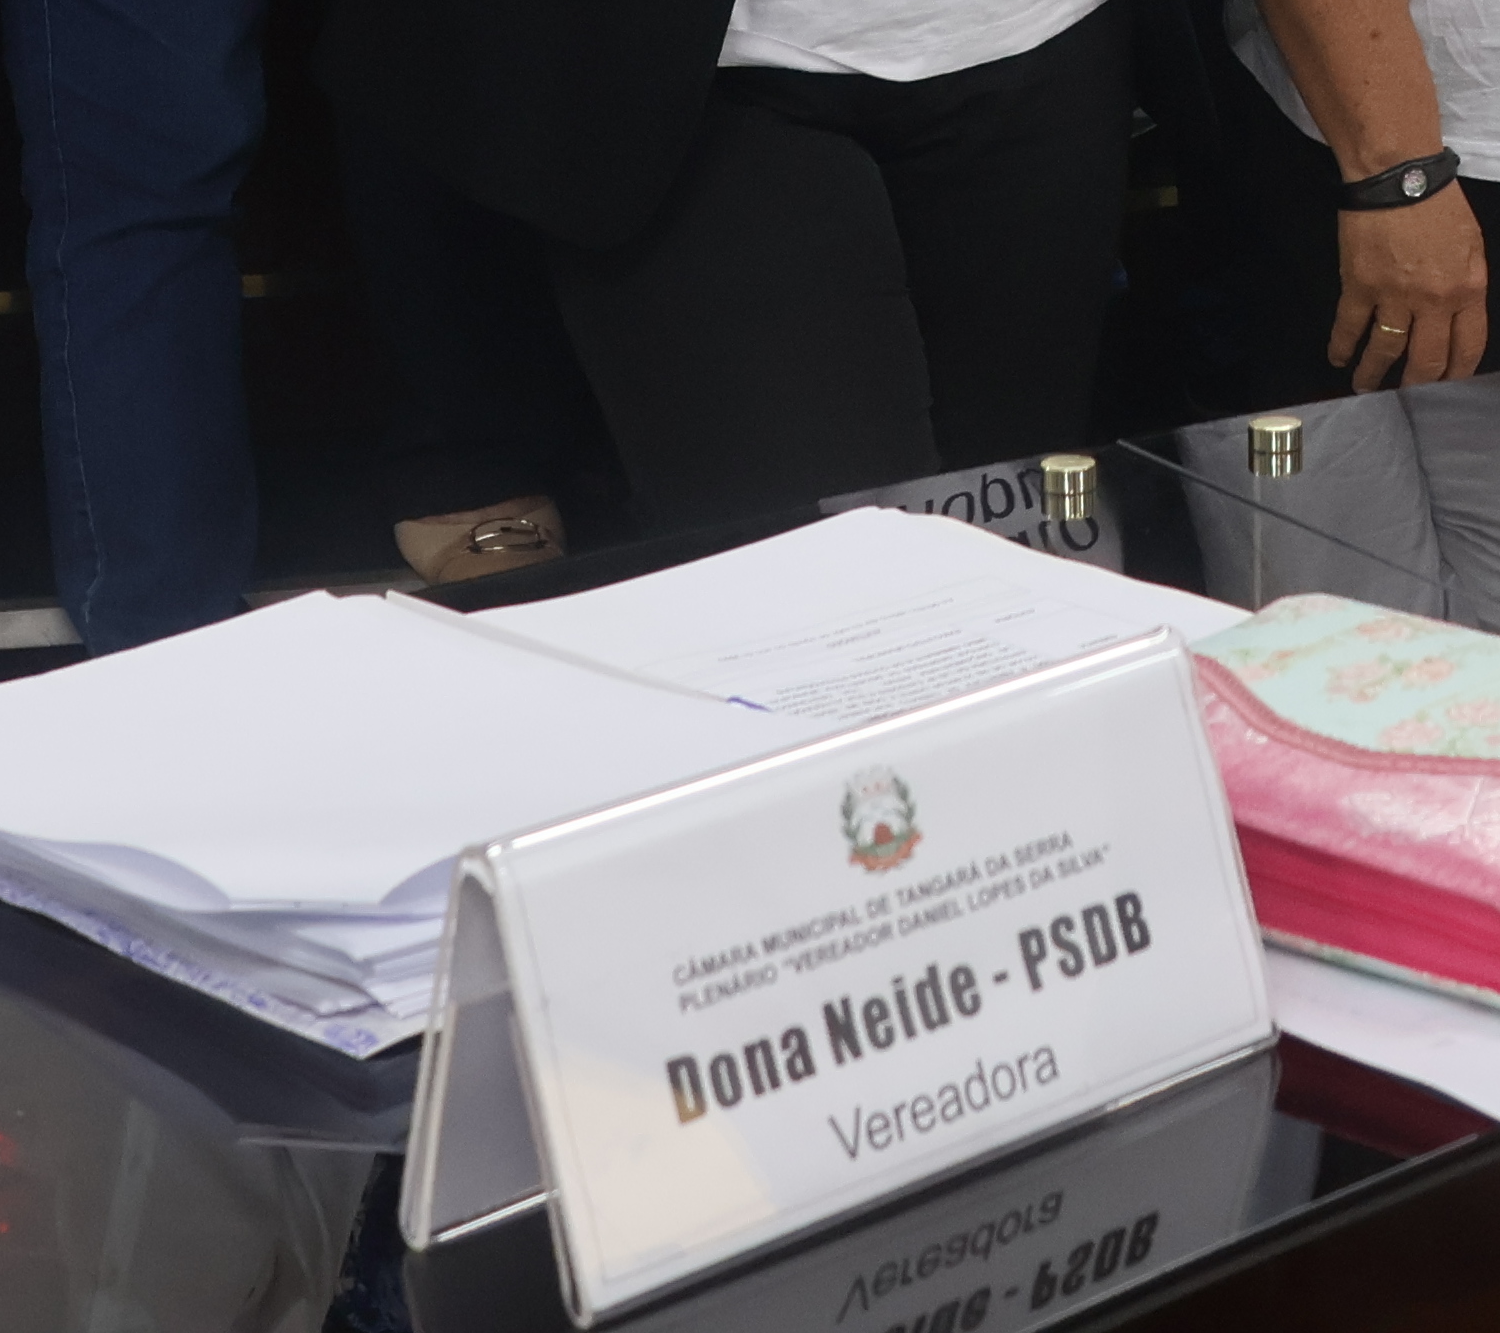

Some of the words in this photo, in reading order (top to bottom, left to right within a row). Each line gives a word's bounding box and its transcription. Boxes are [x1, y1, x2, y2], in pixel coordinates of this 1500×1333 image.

[672, 942, 759, 987] CÂMARA
[761, 905, 863, 955] MUNICIPAL
[865, 894, 892, 919] DE
[896, 860, 983, 907] TANGARÁ
[984, 852, 1011, 877] DA
[1014, 830, 1073, 867] SERRA
[679, 962, 778, 1013] PLENÁRIO
[898, 897, 965, 937] DANIEL
[967, 874, 1026, 912] LOPES
[1029, 865, 1055, 889] DA
[666, 1023, 817, 1125] Dona
[822, 960, 983, 1066] Neide
[1018, 889, 1153, 992] PSDB
[827, 1043, 1060, 1161] Vereadora
